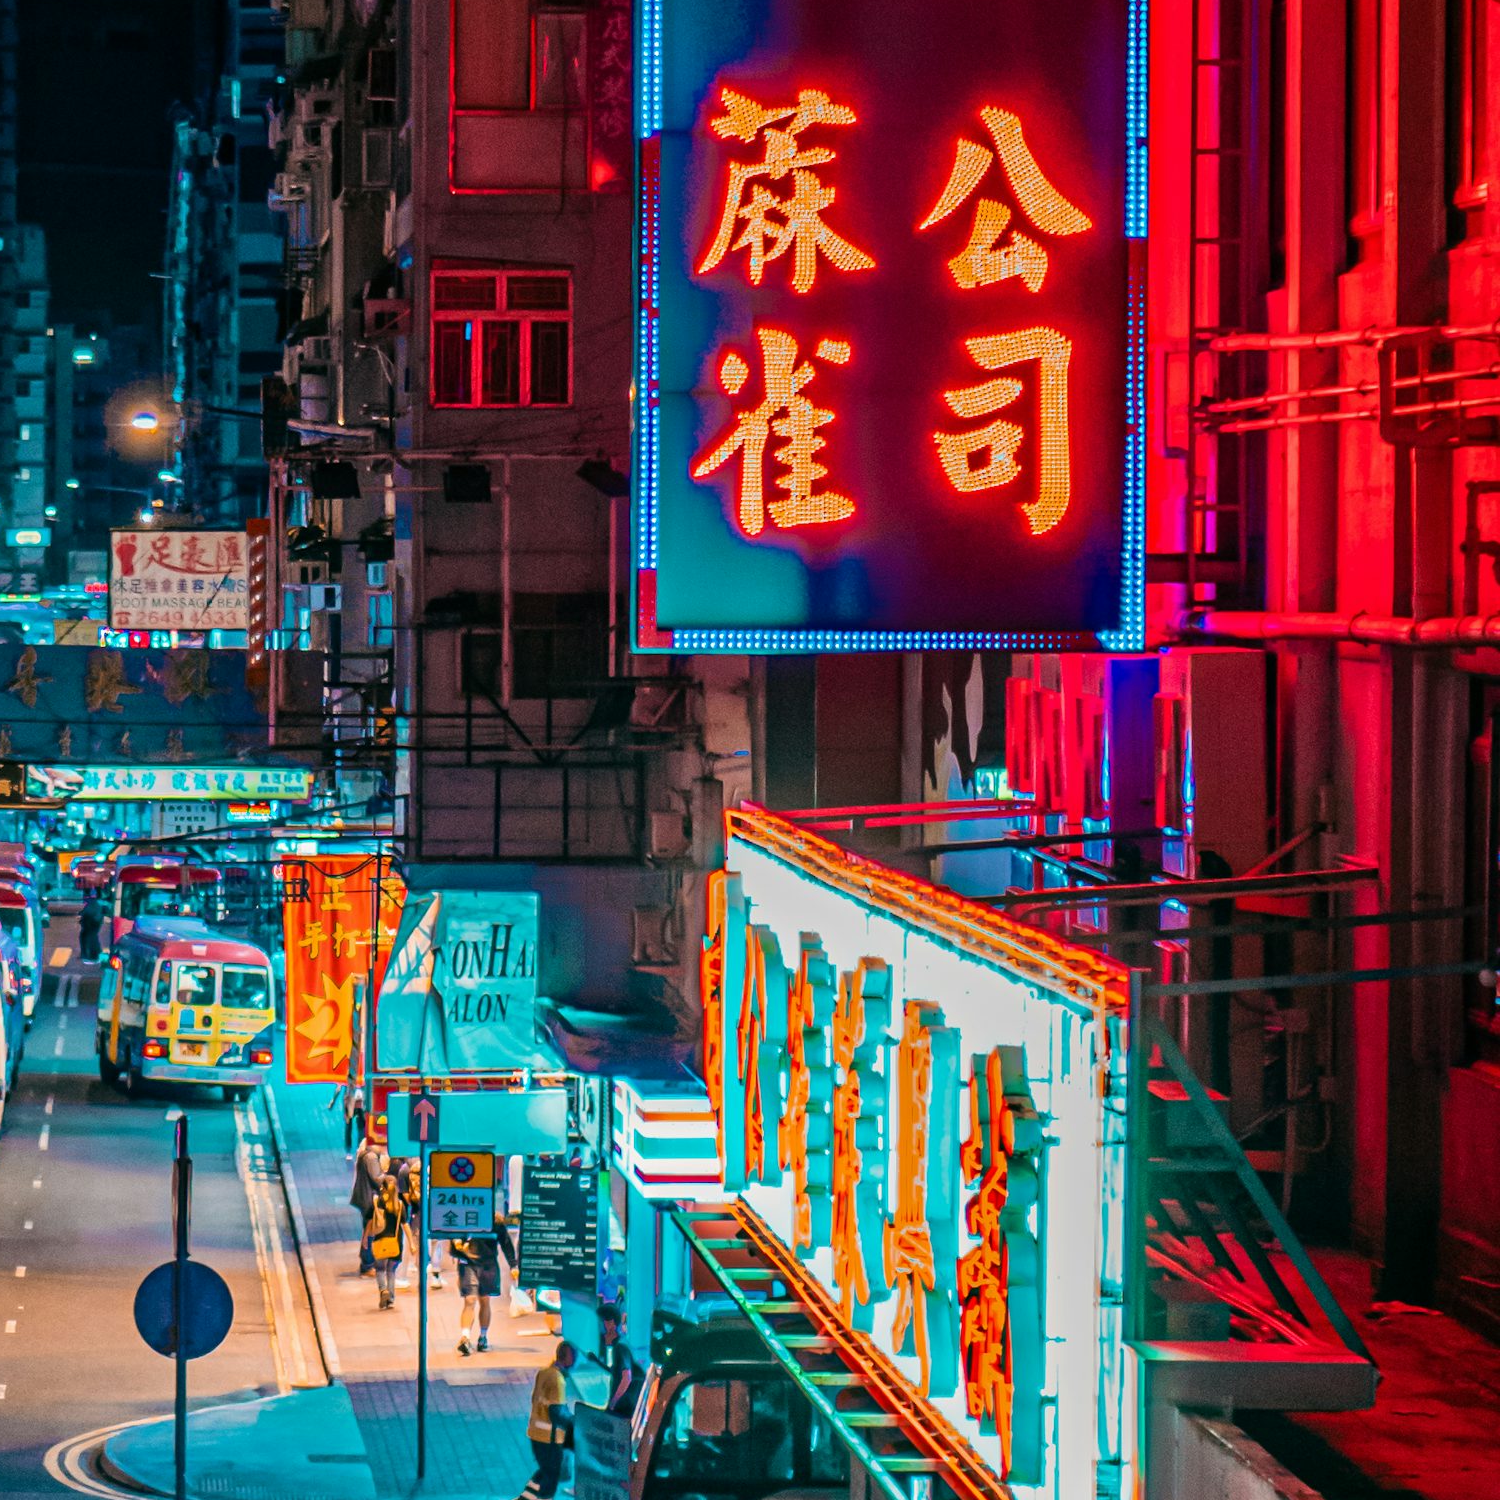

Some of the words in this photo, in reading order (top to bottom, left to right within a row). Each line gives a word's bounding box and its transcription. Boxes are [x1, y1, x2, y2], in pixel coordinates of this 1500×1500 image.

[916, 104, 1095, 536] 公司
[449, 993, 511, 1023] ALON
[437, 1192, 459, 1206] 24
[461, 1192, 485, 1206] hrs
[442, 1210, 479, 1227] 全日
